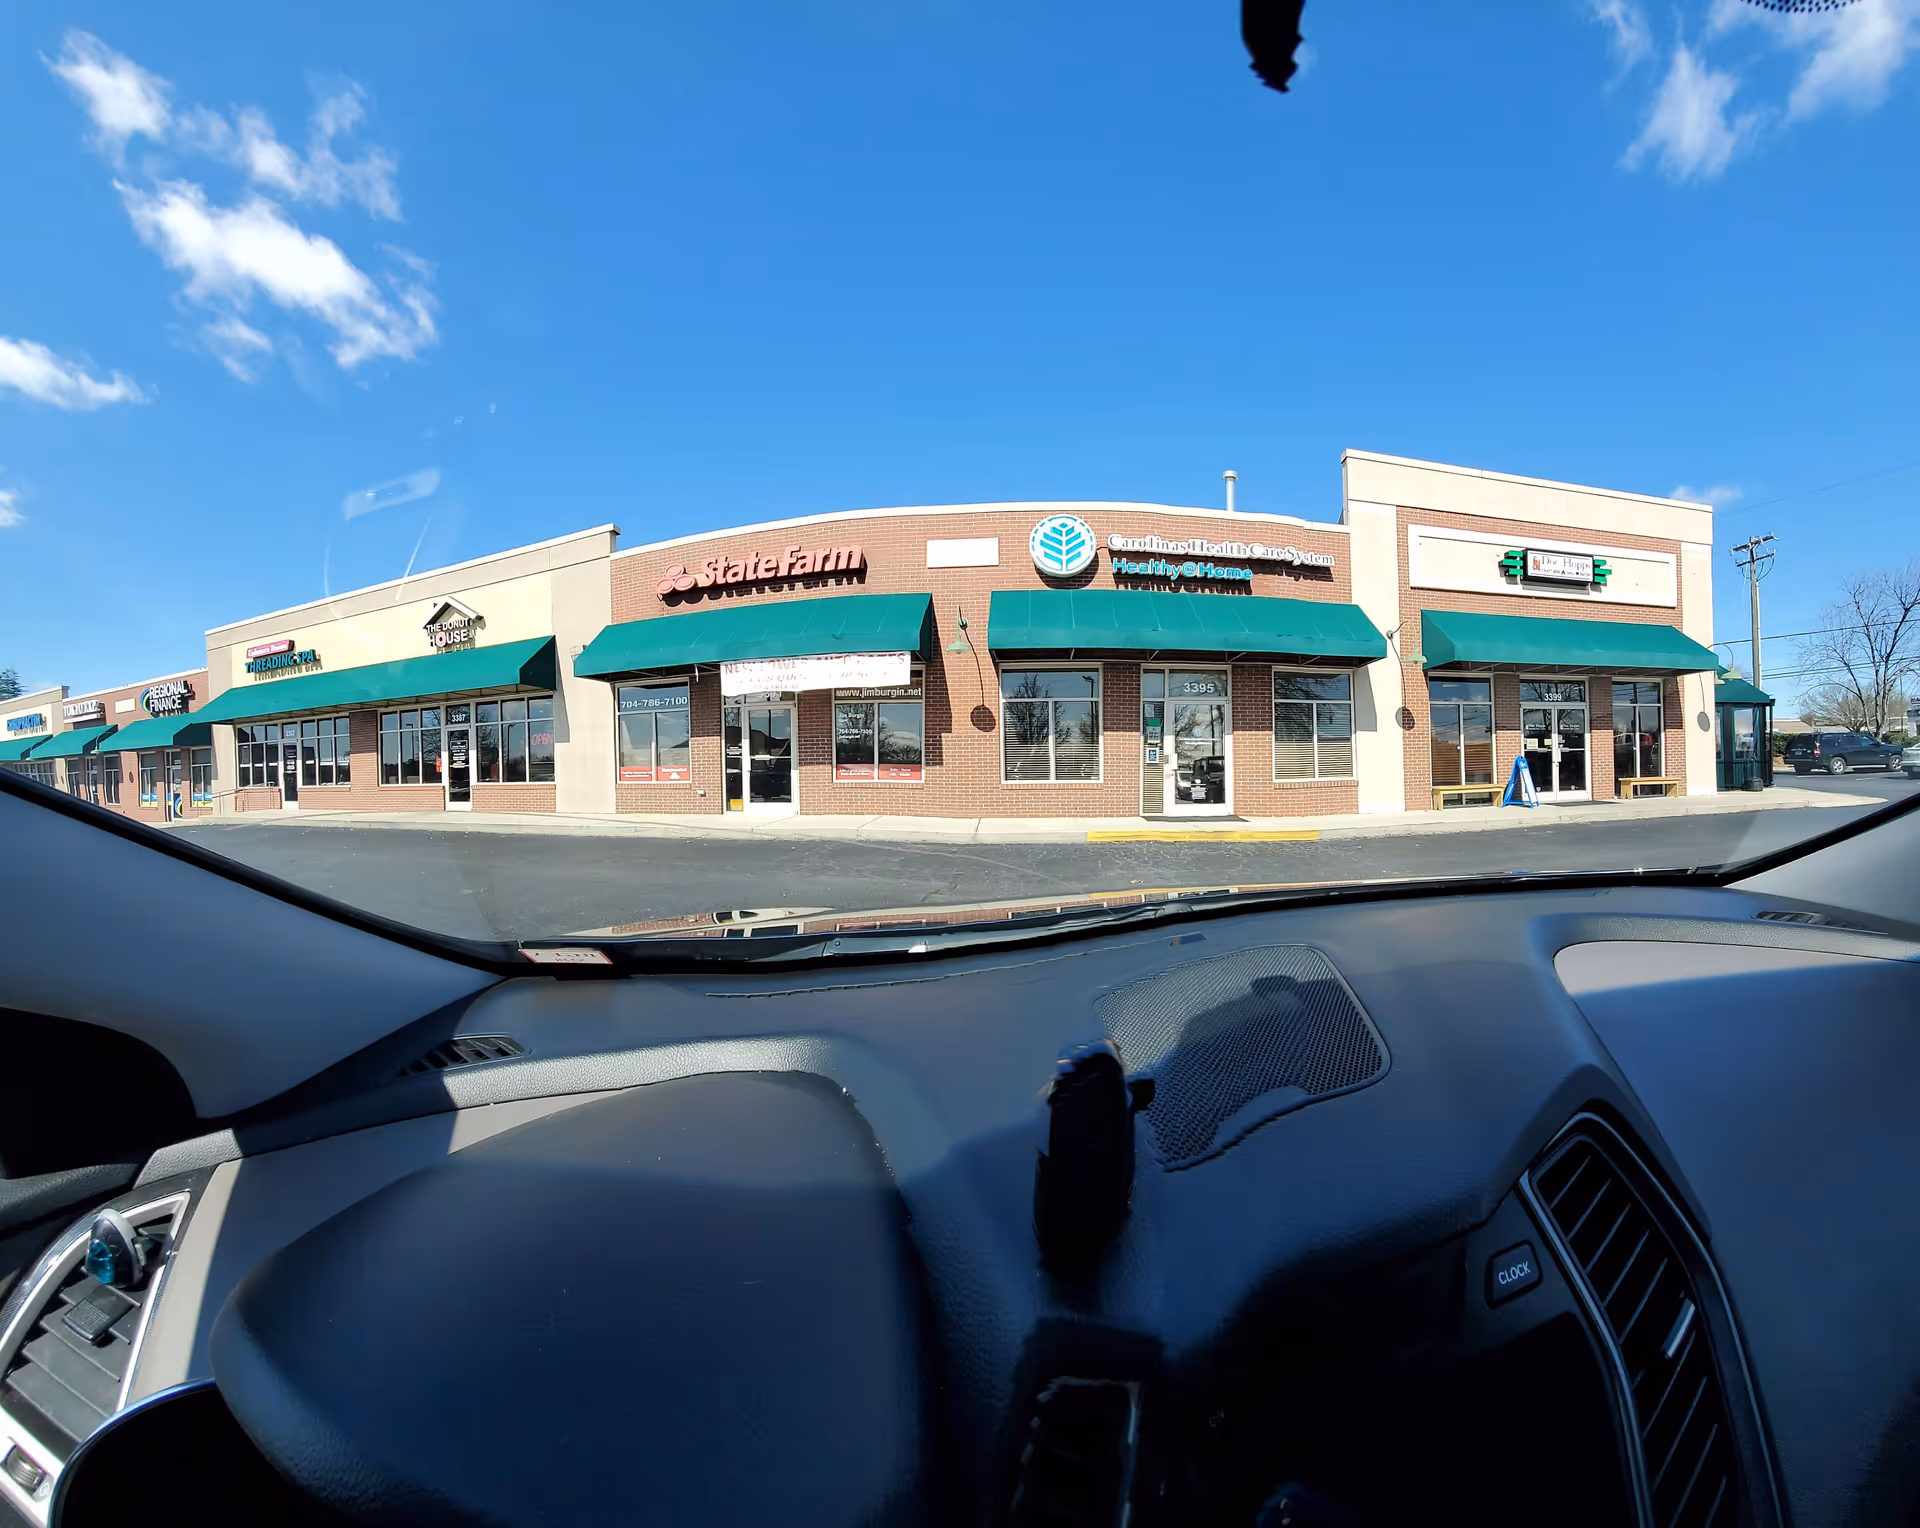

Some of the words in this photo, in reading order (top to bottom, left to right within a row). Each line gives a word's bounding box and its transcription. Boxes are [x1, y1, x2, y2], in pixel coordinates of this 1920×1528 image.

[1112, 557, 1253, 582] Healthy@Home
[426, 622, 442, 634] THE
[442, 617, 470, 631] DONUT
[428, 629, 469, 648] HOUSE
[244, 653, 295, 674] THREADING
[295, 648, 315, 665] SPA
[149, 680, 187, 699] REGIONAL
[1183, 682, 1215, 693] 3395
[150, 695, 182, 713] FINANCE
[620, 696, 688, 709] 704-786-7100
[1544, 693, 1562, 702] 3399
[531, 732, 554, 747] OPEN
[1498, 1260, 1532, 1285] CLOCK
